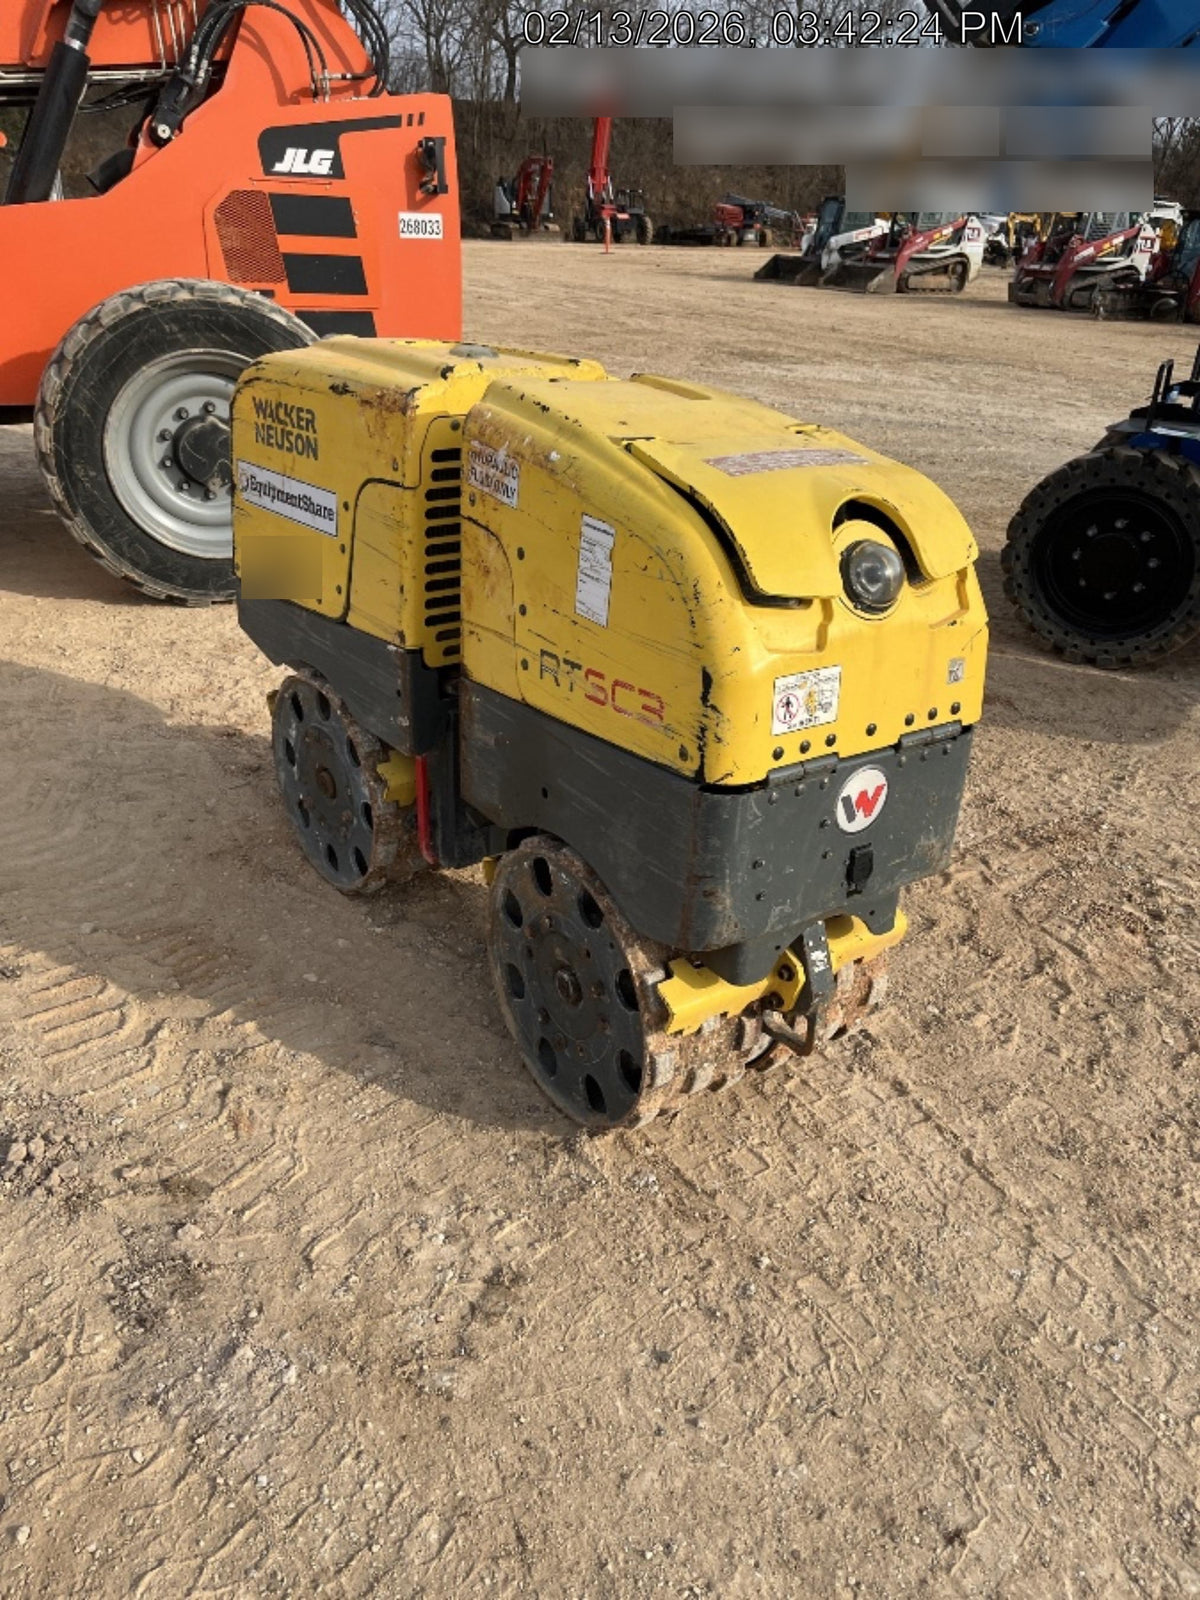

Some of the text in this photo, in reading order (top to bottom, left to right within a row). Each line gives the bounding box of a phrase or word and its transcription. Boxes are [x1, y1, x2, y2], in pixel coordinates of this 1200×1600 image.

[272, 147, 335, 175] JLG
[400, 218, 442, 236] 268033
[252, 395, 318, 435] WACKER
[255, 421, 319, 461] NEUSON
[249, 475, 336, 521] EquipmentShare
[540, 649, 665, 727] RTSC3
